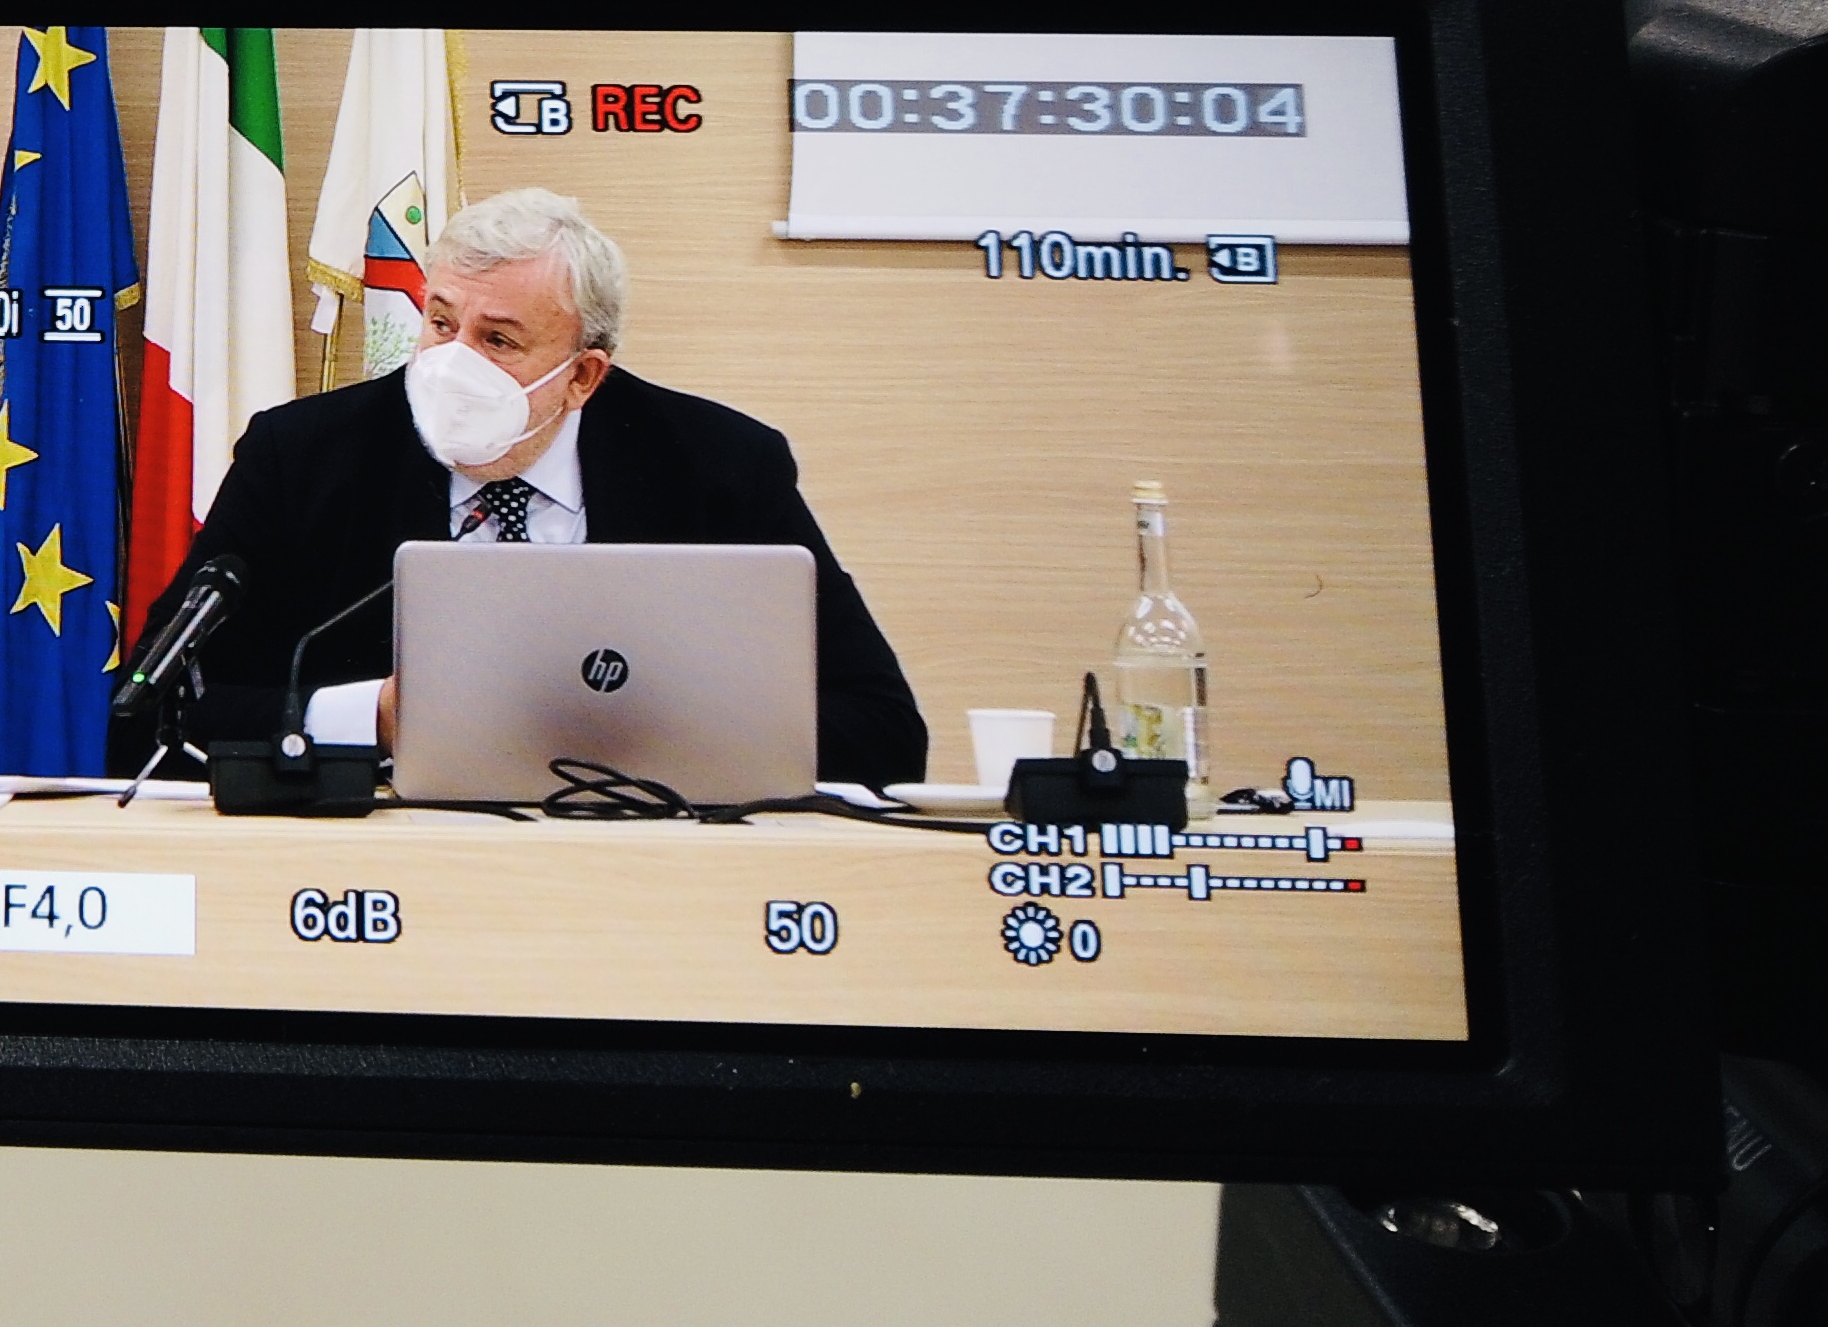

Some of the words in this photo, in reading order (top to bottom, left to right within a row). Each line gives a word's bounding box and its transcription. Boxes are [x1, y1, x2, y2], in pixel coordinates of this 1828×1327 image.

[593, 85, 701, 131] REC
[792, 81, 1304, 135] 00:37:30:04
[976, 230, 1189, 281] 110min.
[55, 297, 91, 331] 50
[586, 648, 625, 693] hp
[1313, 778, 1352, 810] MI
[988, 823, 1087, 855] CH1
[990, 863, 1094, 897] CH2
[3, 884, 108, 937] F4,0
[291, 889, 399, 942] 6dB
[767, 902, 837, 953] 50
